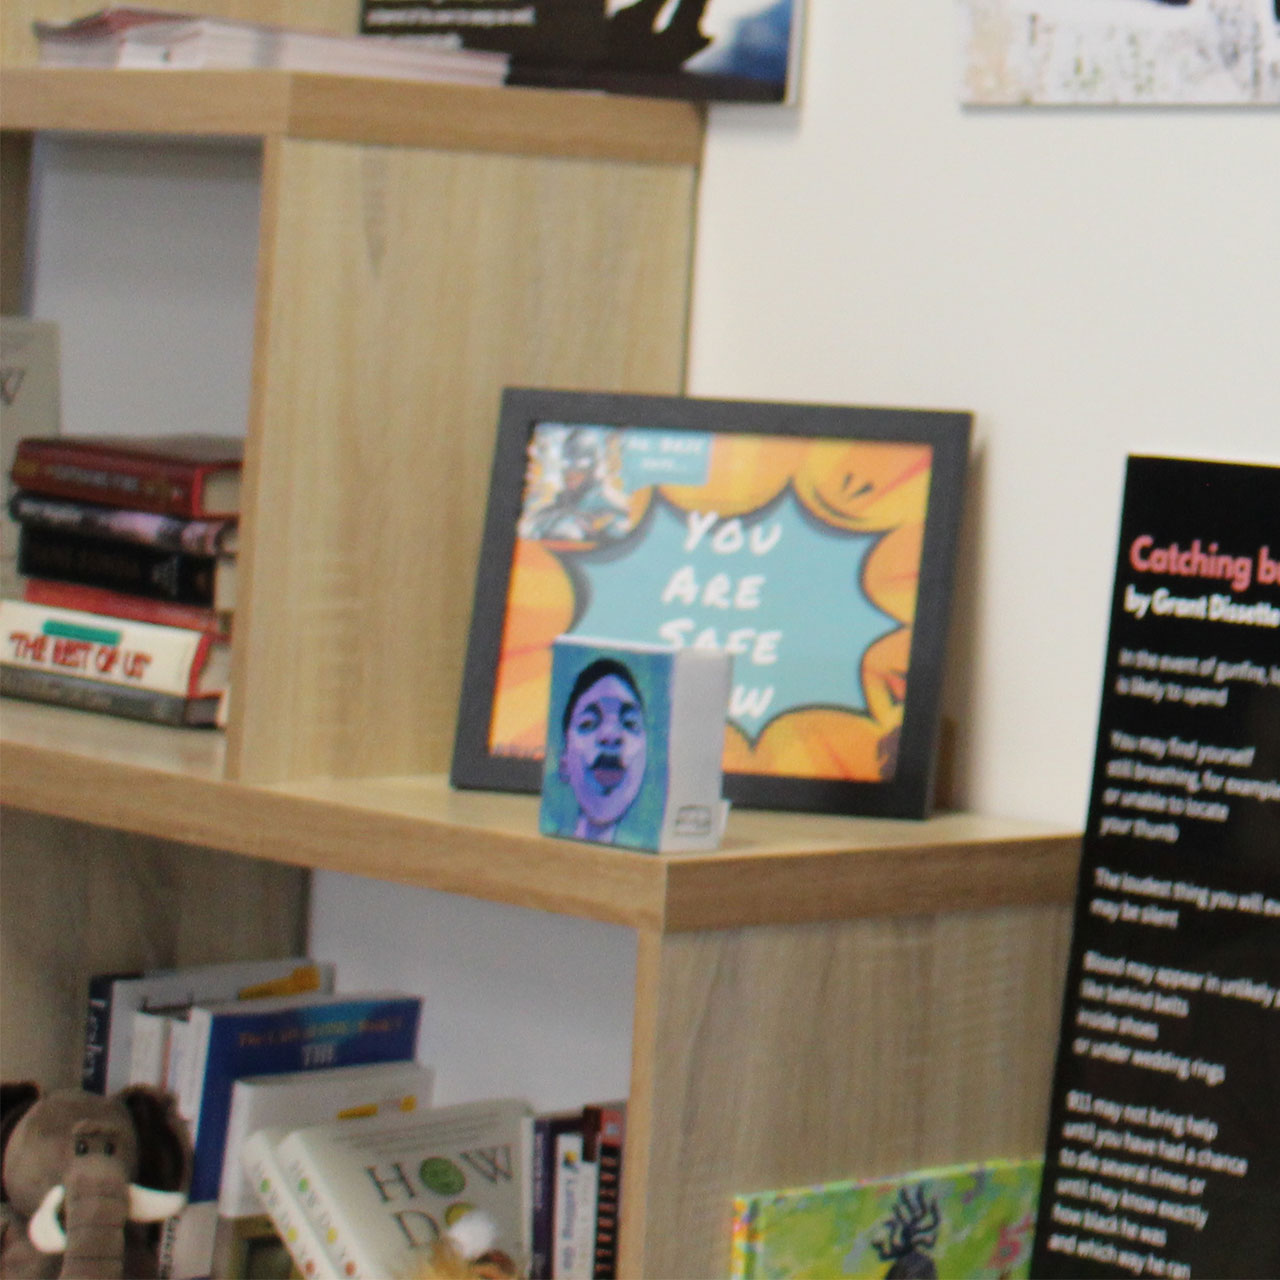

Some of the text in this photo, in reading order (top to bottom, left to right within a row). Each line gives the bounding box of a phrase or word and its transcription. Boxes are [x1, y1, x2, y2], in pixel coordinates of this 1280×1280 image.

[684, 509, 782, 556] YOU
[1130, 534, 1251, 592] Catching
[661, 564, 765, 610] ARE
[1124, 584, 1151, 619] by
[1152, 587, 1206, 620] Grant
[659, 617, 782, 665] SAFE
[1200, 656, 1217, 676] of
